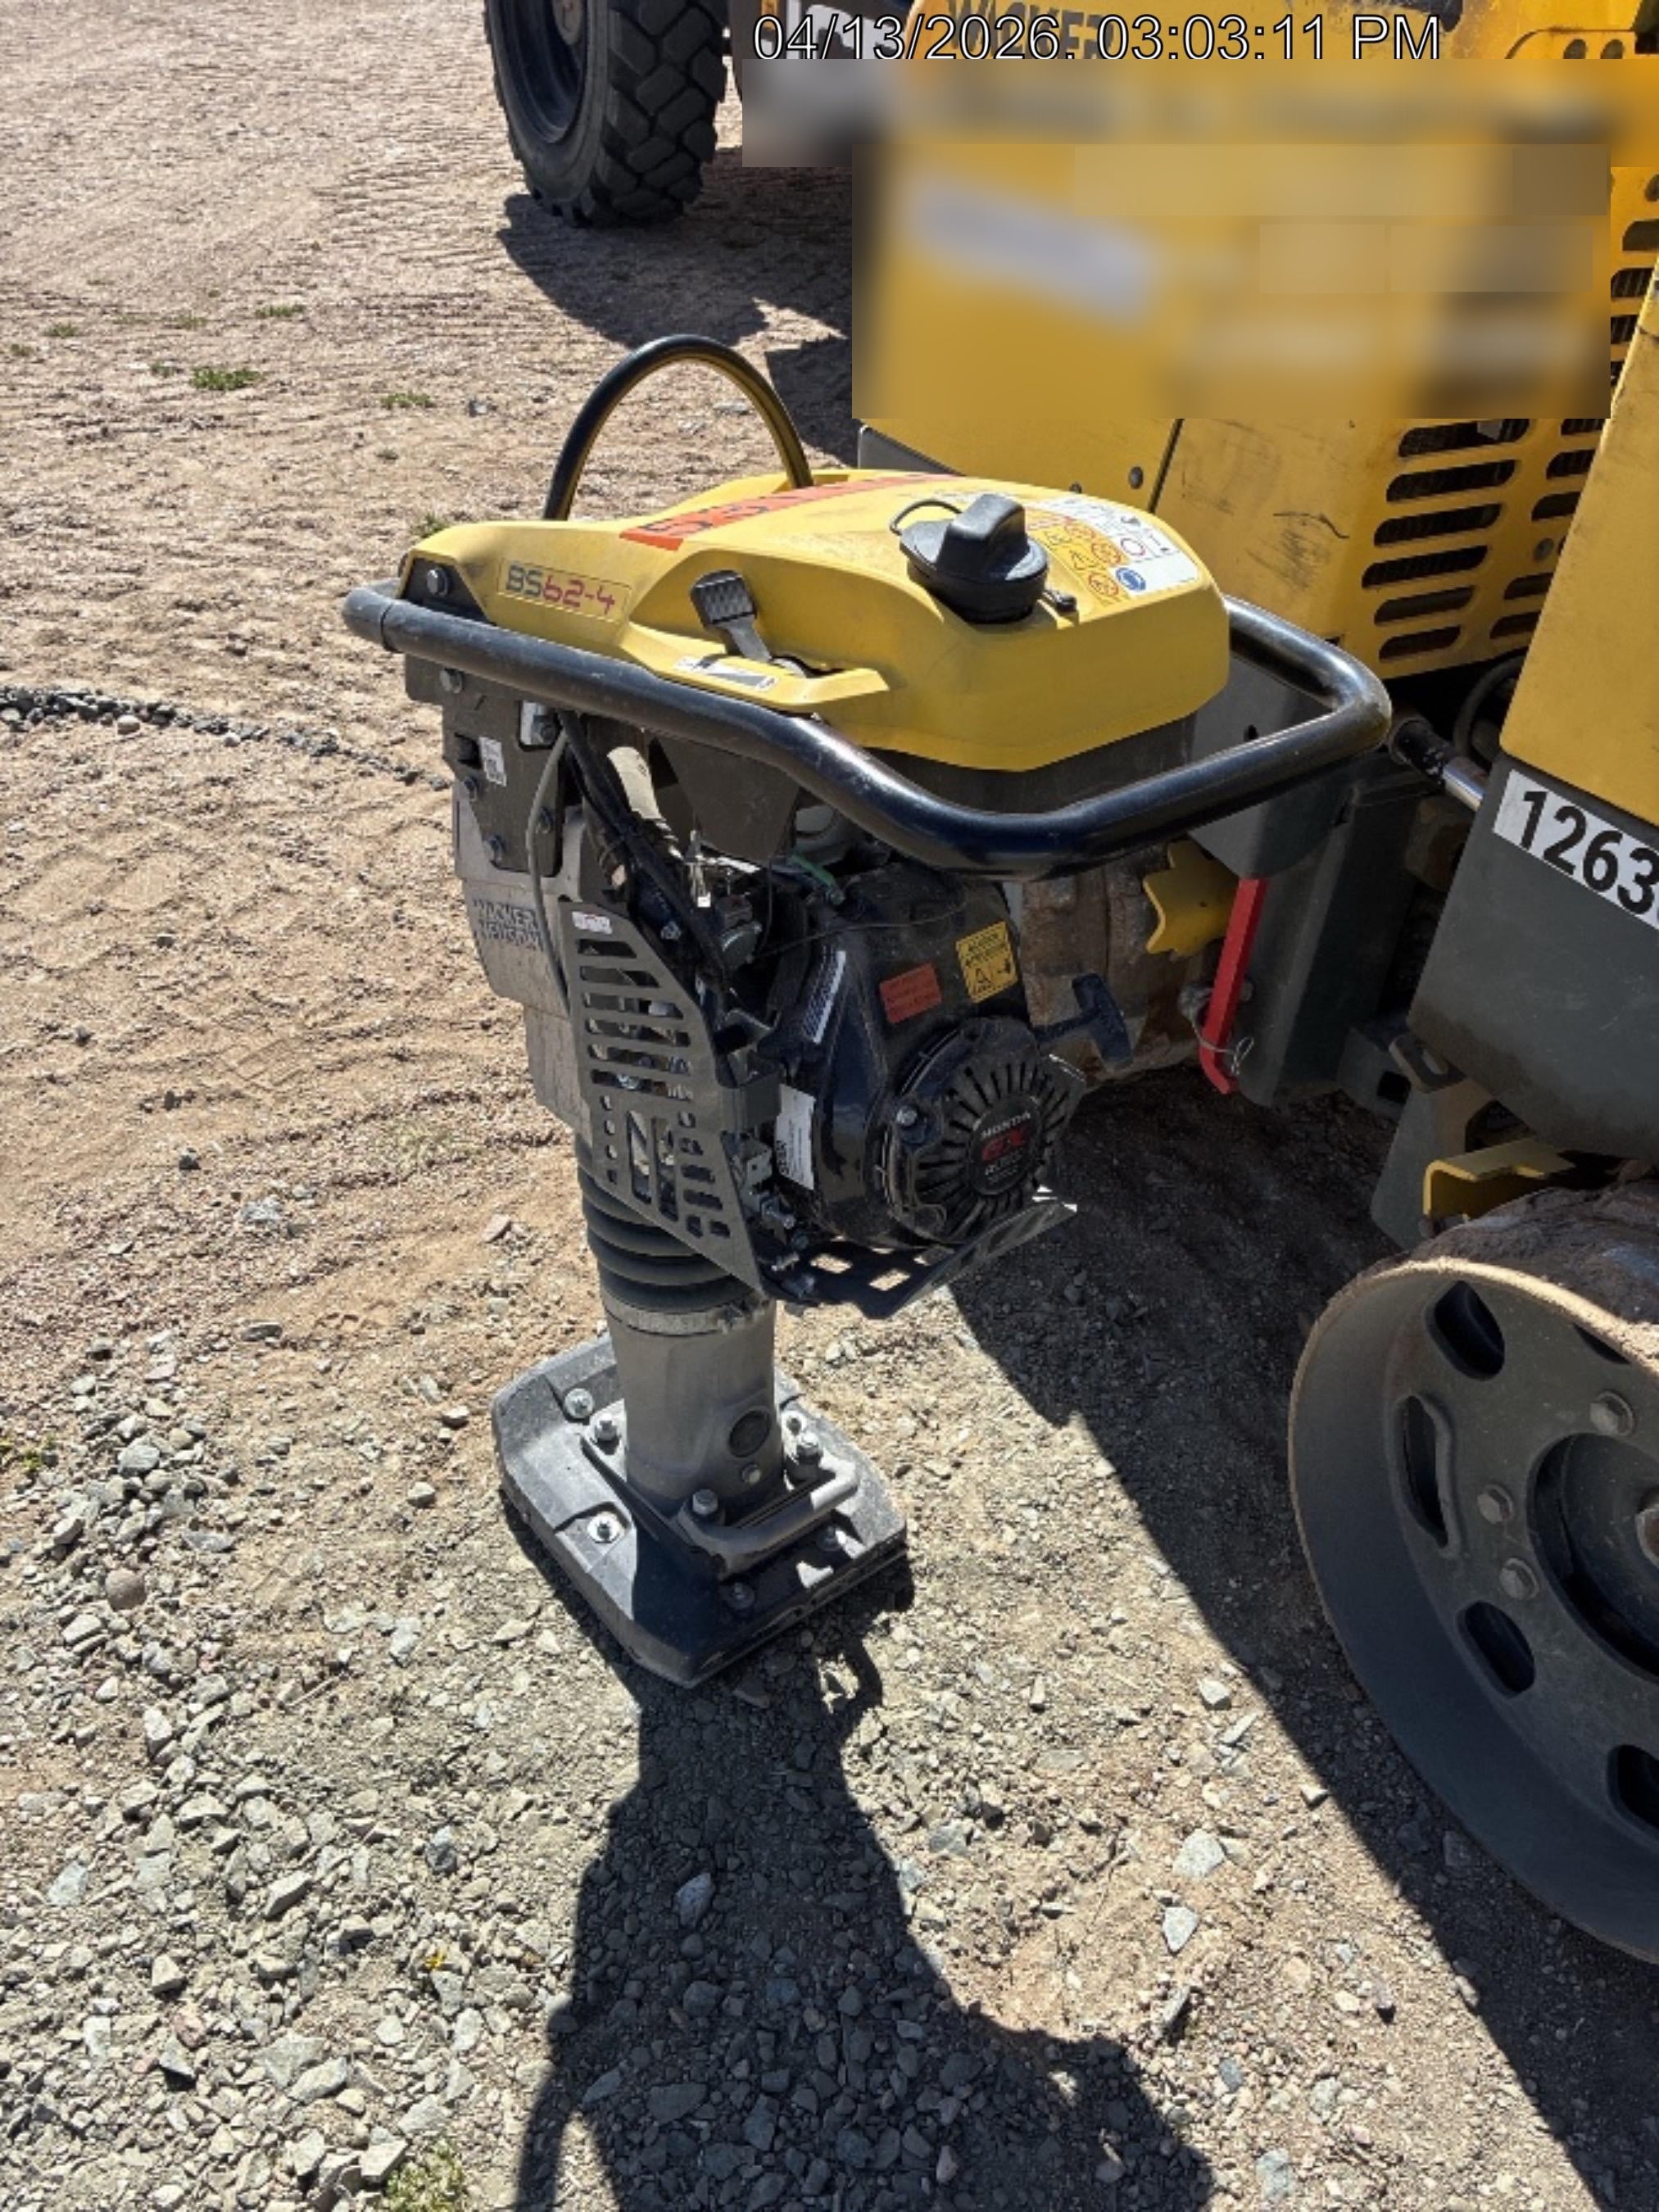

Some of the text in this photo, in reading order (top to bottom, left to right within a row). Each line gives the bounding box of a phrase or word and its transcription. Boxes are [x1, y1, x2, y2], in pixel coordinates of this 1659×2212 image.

[505, 564, 615, 614] BS62-4
[1521, 791, 1659, 914] 1263
[981, 1110, 1031, 1139] HONDA
